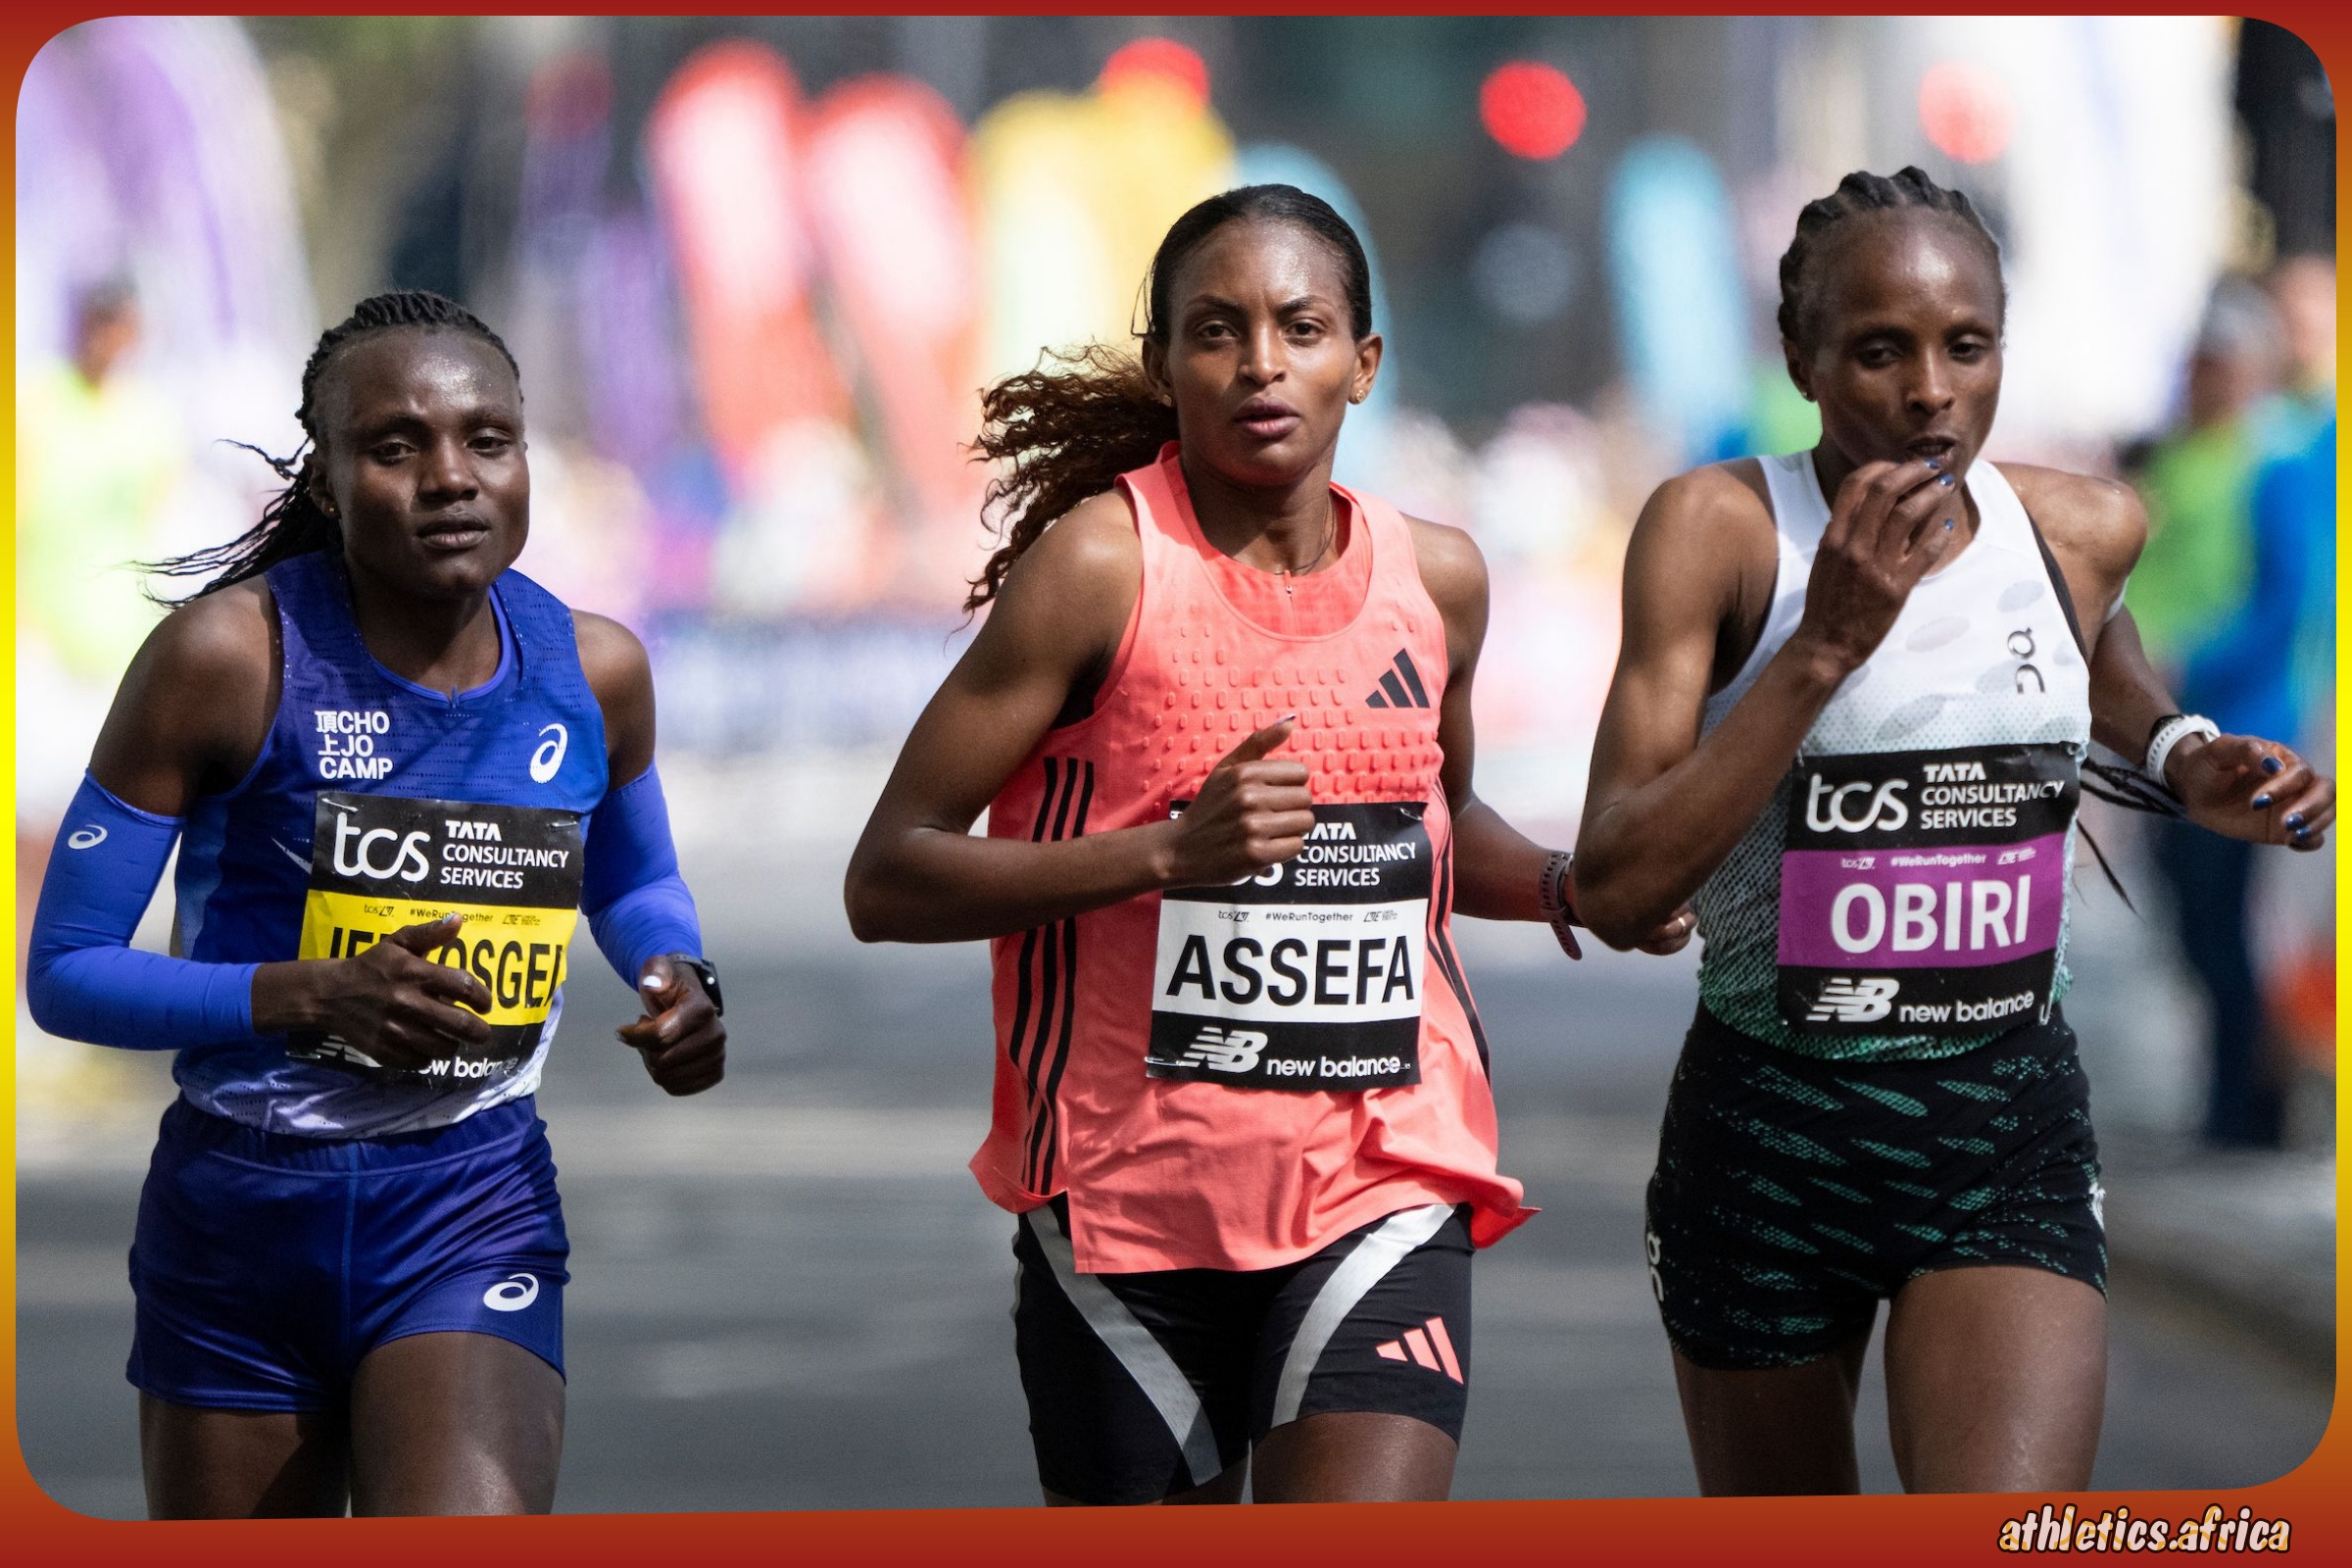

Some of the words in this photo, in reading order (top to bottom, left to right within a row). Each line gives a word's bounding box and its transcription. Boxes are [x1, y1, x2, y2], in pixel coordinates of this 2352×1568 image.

[319, 757, 393, 780] CAMP
[1923, 761, 1986, 783] TATA
[1806, 772, 1910, 833] tcs
[1921, 780, 2065, 806] CONSULTANCY
[445, 819, 502, 842] TATA
[1920, 808, 2017, 830] SERVICES
[1302, 822, 1356, 841] ATA
[333, 811, 430, 882] tcs
[442, 844, 569, 869] CONSULTANCY
[440, 866, 523, 890] SERVICES
[1295, 867, 1381, 887] SERVICES
[1265, 911, 1353, 923] #WeRunTogether
[1831, 874, 2032, 955] OBIRI
[1166, 934, 1415, 1006] ASSEFA
[1898, 1003, 1950, 1023] new
[1955, 990, 2035, 1023] balance
[1266, 1058, 1316, 1077] new
[1320, 1055, 1401, 1078] balance
